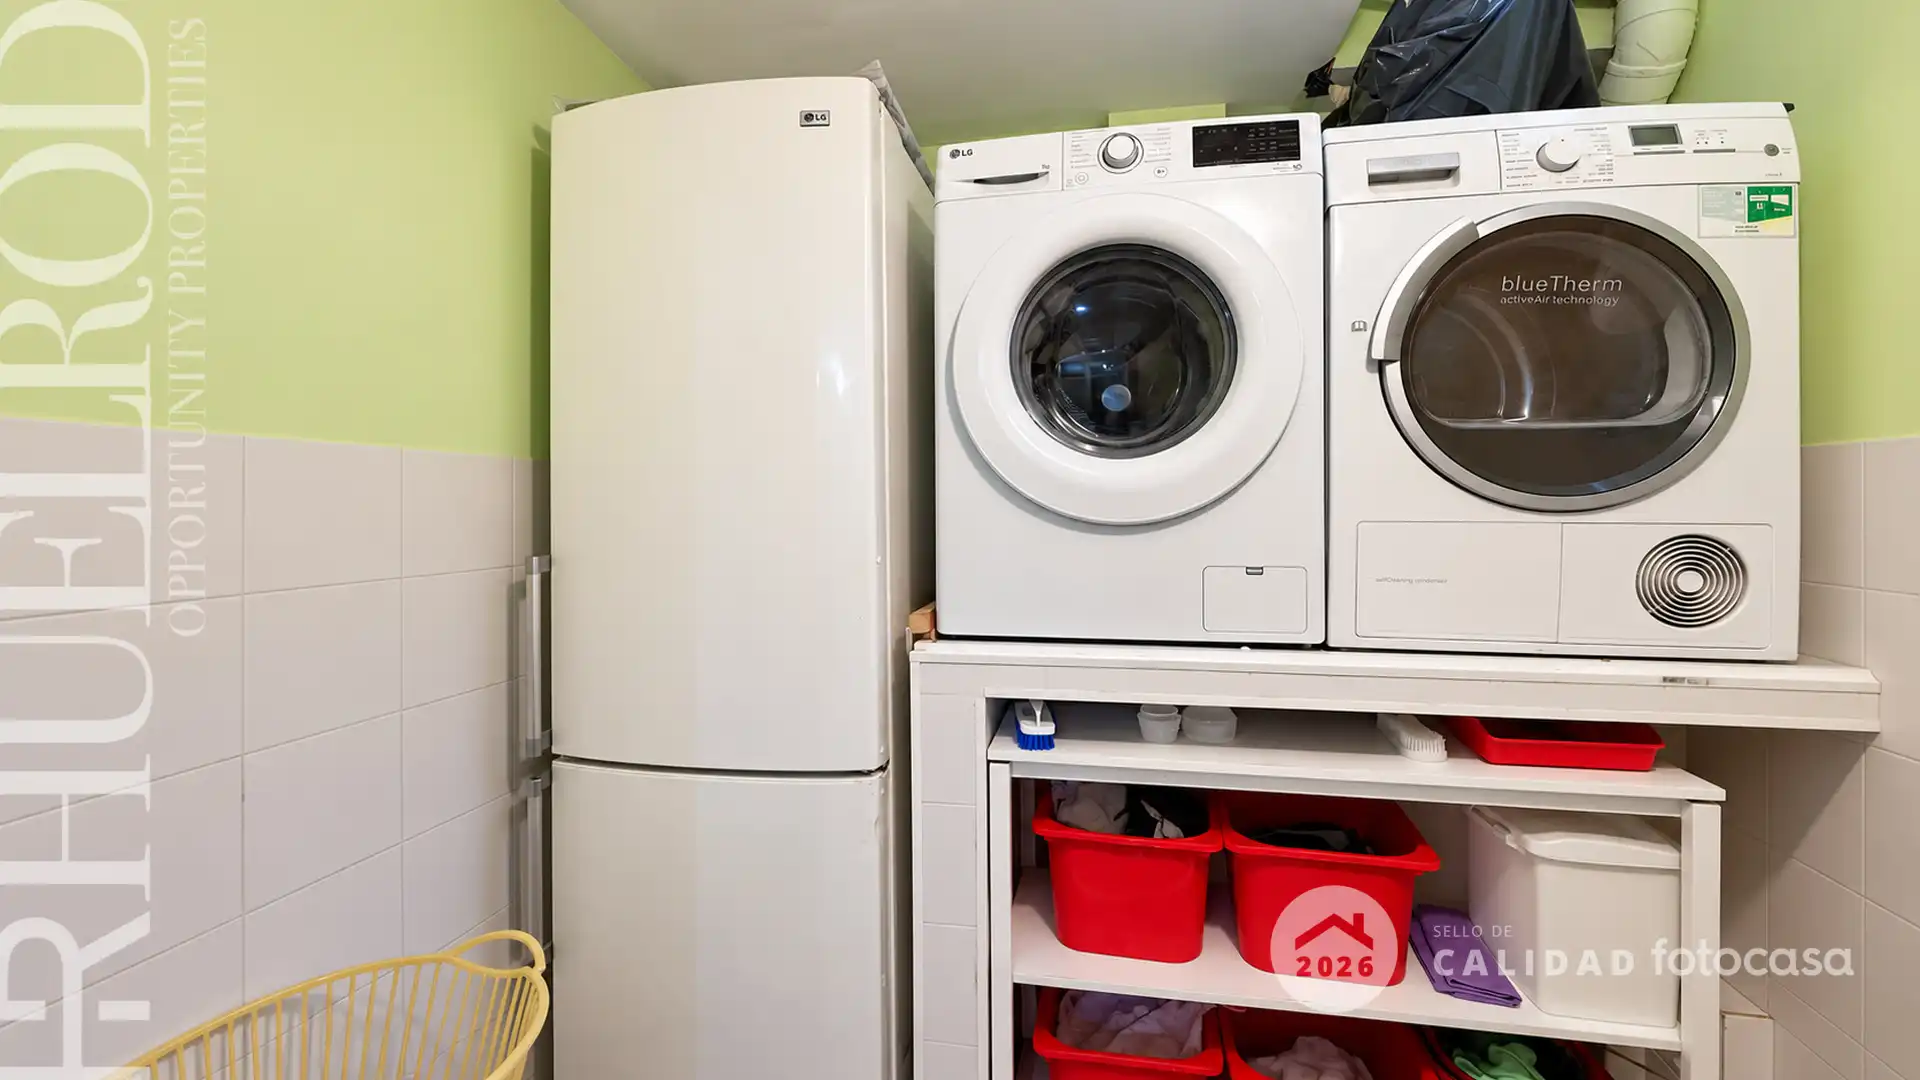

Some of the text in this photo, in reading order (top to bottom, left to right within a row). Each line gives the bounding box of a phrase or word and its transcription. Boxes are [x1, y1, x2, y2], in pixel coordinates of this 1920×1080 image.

[815, 113, 827, 121] LG
[961, 148, 973, 157] LG
[1501, 275, 1623, 292] blueTherm
[1500, 295, 1620, 307] activeAir technology
